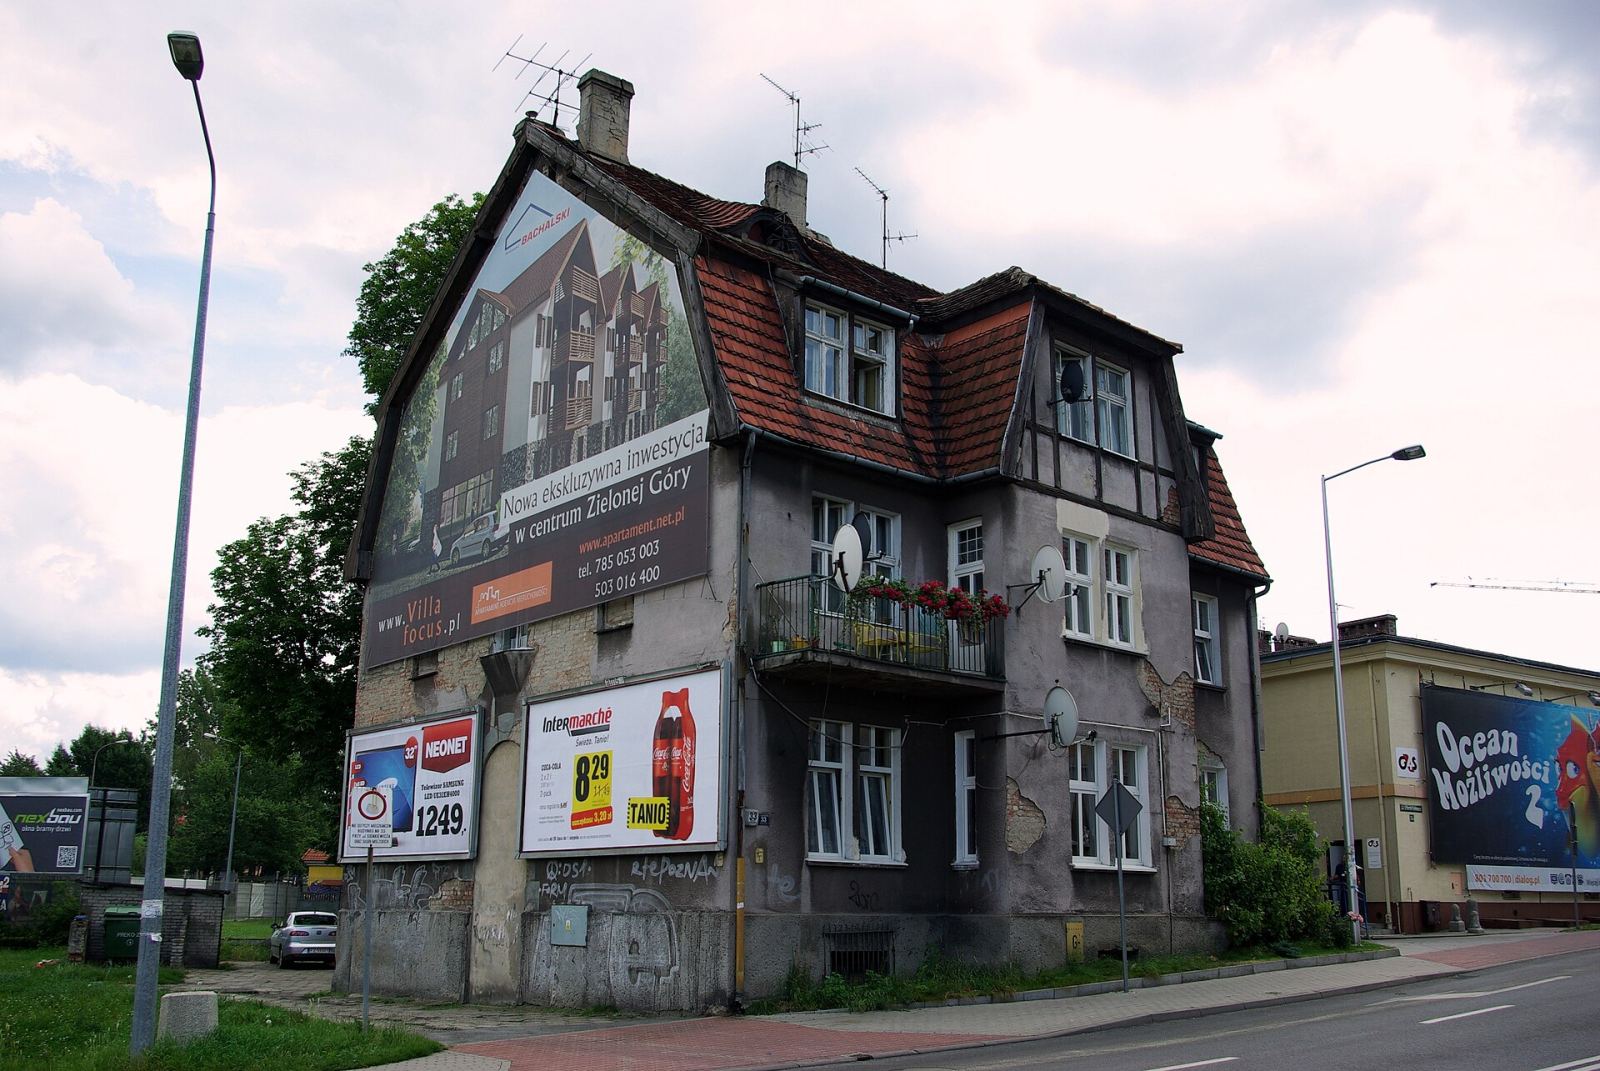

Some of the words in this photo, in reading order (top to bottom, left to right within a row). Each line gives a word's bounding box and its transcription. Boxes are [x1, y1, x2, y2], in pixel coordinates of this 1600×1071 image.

[502, 492, 538, 519] Nowa
[542, 458, 621, 504] ekskluzywna
[627, 424, 704, 471] inwestycja
[515, 527, 526, 544] w
[529, 506, 582, 540] centrum
[586, 477, 644, 519] Zielonej
[649, 465, 692, 495] Góry
[578, 506, 685, 554] www.apartament.net.pl
[578, 562, 592, 578] tel.
[596, 554, 614, 574] 785
[616, 547, 636, 566] 053
[640, 540, 660, 560] 003
[595, 579, 613, 598] 503
[616, 572, 636, 591] 016
[640, 566, 660, 584] 400
[542, 707, 612, 737] Intermarché
[425, 736, 468, 758] NEONET
[1436, 721, 1518, 773] Ocean
[541, 762, 562, 771] COCA-COLA
[1432, 754, 1550, 811] Możliwości
[14, 808, 82, 824] nexbau
[630, 803, 666, 824] TANIO
[1525, 784, 1544, 830] 2
